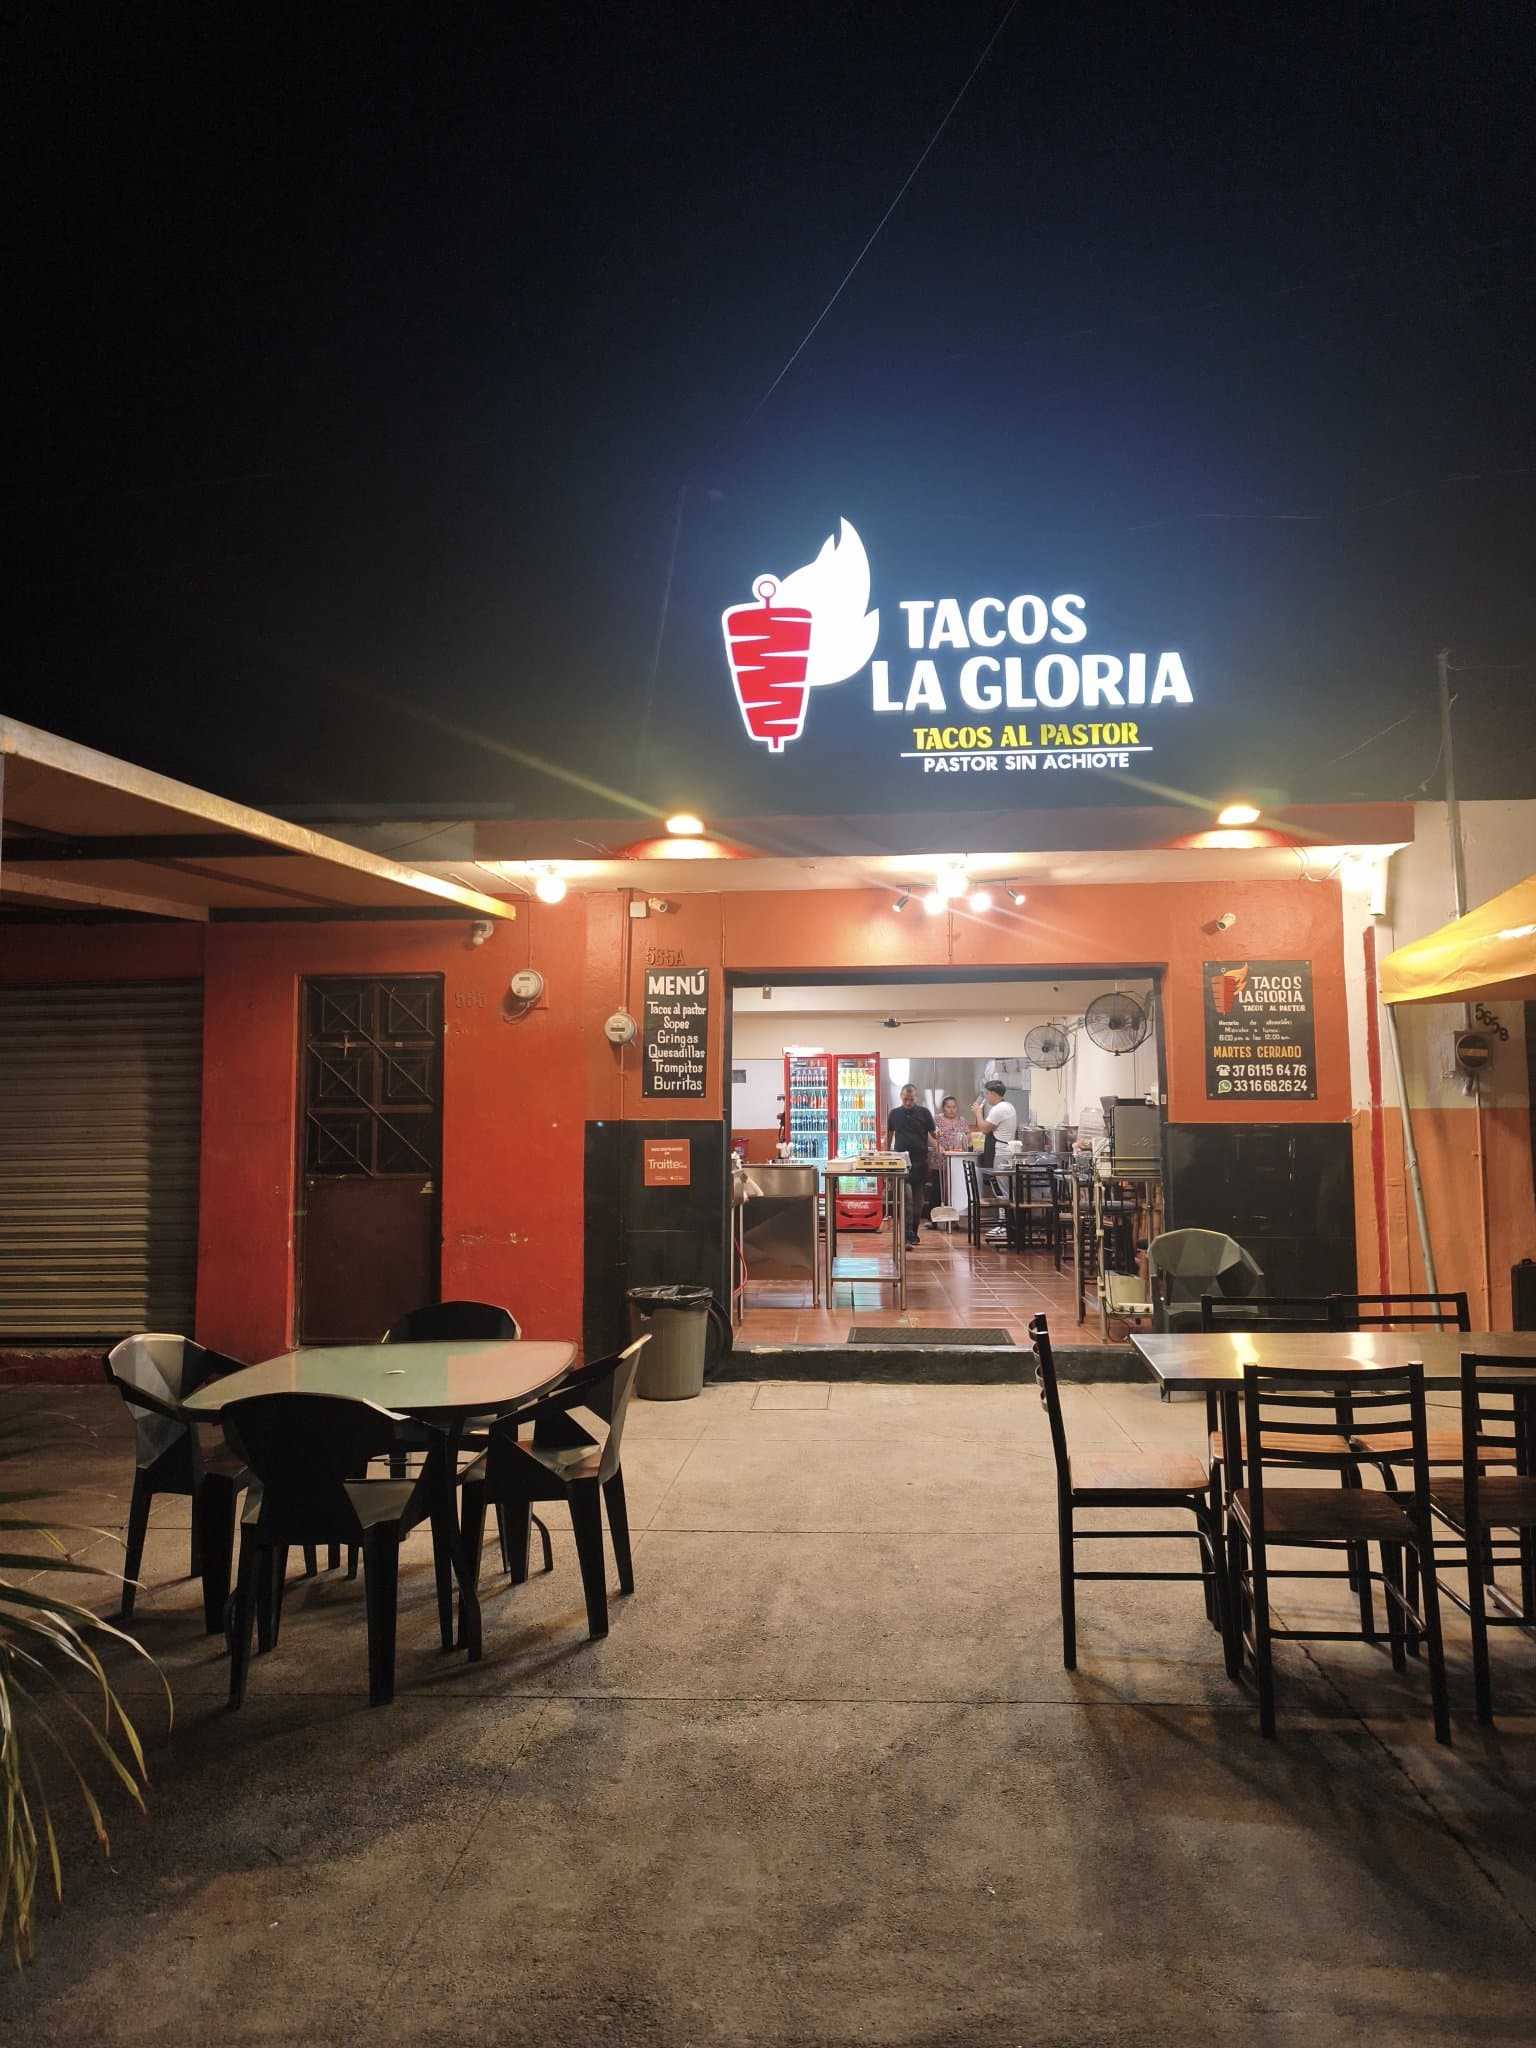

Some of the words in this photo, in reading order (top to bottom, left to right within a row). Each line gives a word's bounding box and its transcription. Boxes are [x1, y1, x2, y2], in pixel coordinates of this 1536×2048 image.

[899, 594, 1088, 650] TACOS
[871, 659, 948, 713] LA
[959, 651, 1195, 711] GLORIA
[912, 726, 993, 750] TACOS
[1000, 725, 1034, 747] AL
[1040, 721, 1140, 746] PASTOR
[923, 756, 999, 773] PASTOR
[1004, 755, 1037, 770] SIN
[1042, 752, 1130, 770] ACHIOTE
[648, 969, 705, 996] MENÚ
[1250, 976, 1302, 990] TACOS
[1238, 990, 1254, 1003] LA
[1255, 990, 1303, 1003] GLORIA
[646, 1000, 672, 1015] Tacos
[673, 1002, 681, 1015] al
[682, 1002, 707, 1019] pastor
[663, 1015, 690, 1032] Sopes
[657, 1030, 699, 1048] Gringas
[648, 1043, 706, 1059] Quesadillas
[1213, 1045, 1252, 1059] MARTES
[1256, 1045, 1302, 1059] CERRADO
[651, 1058, 704, 1077] Trompitos
